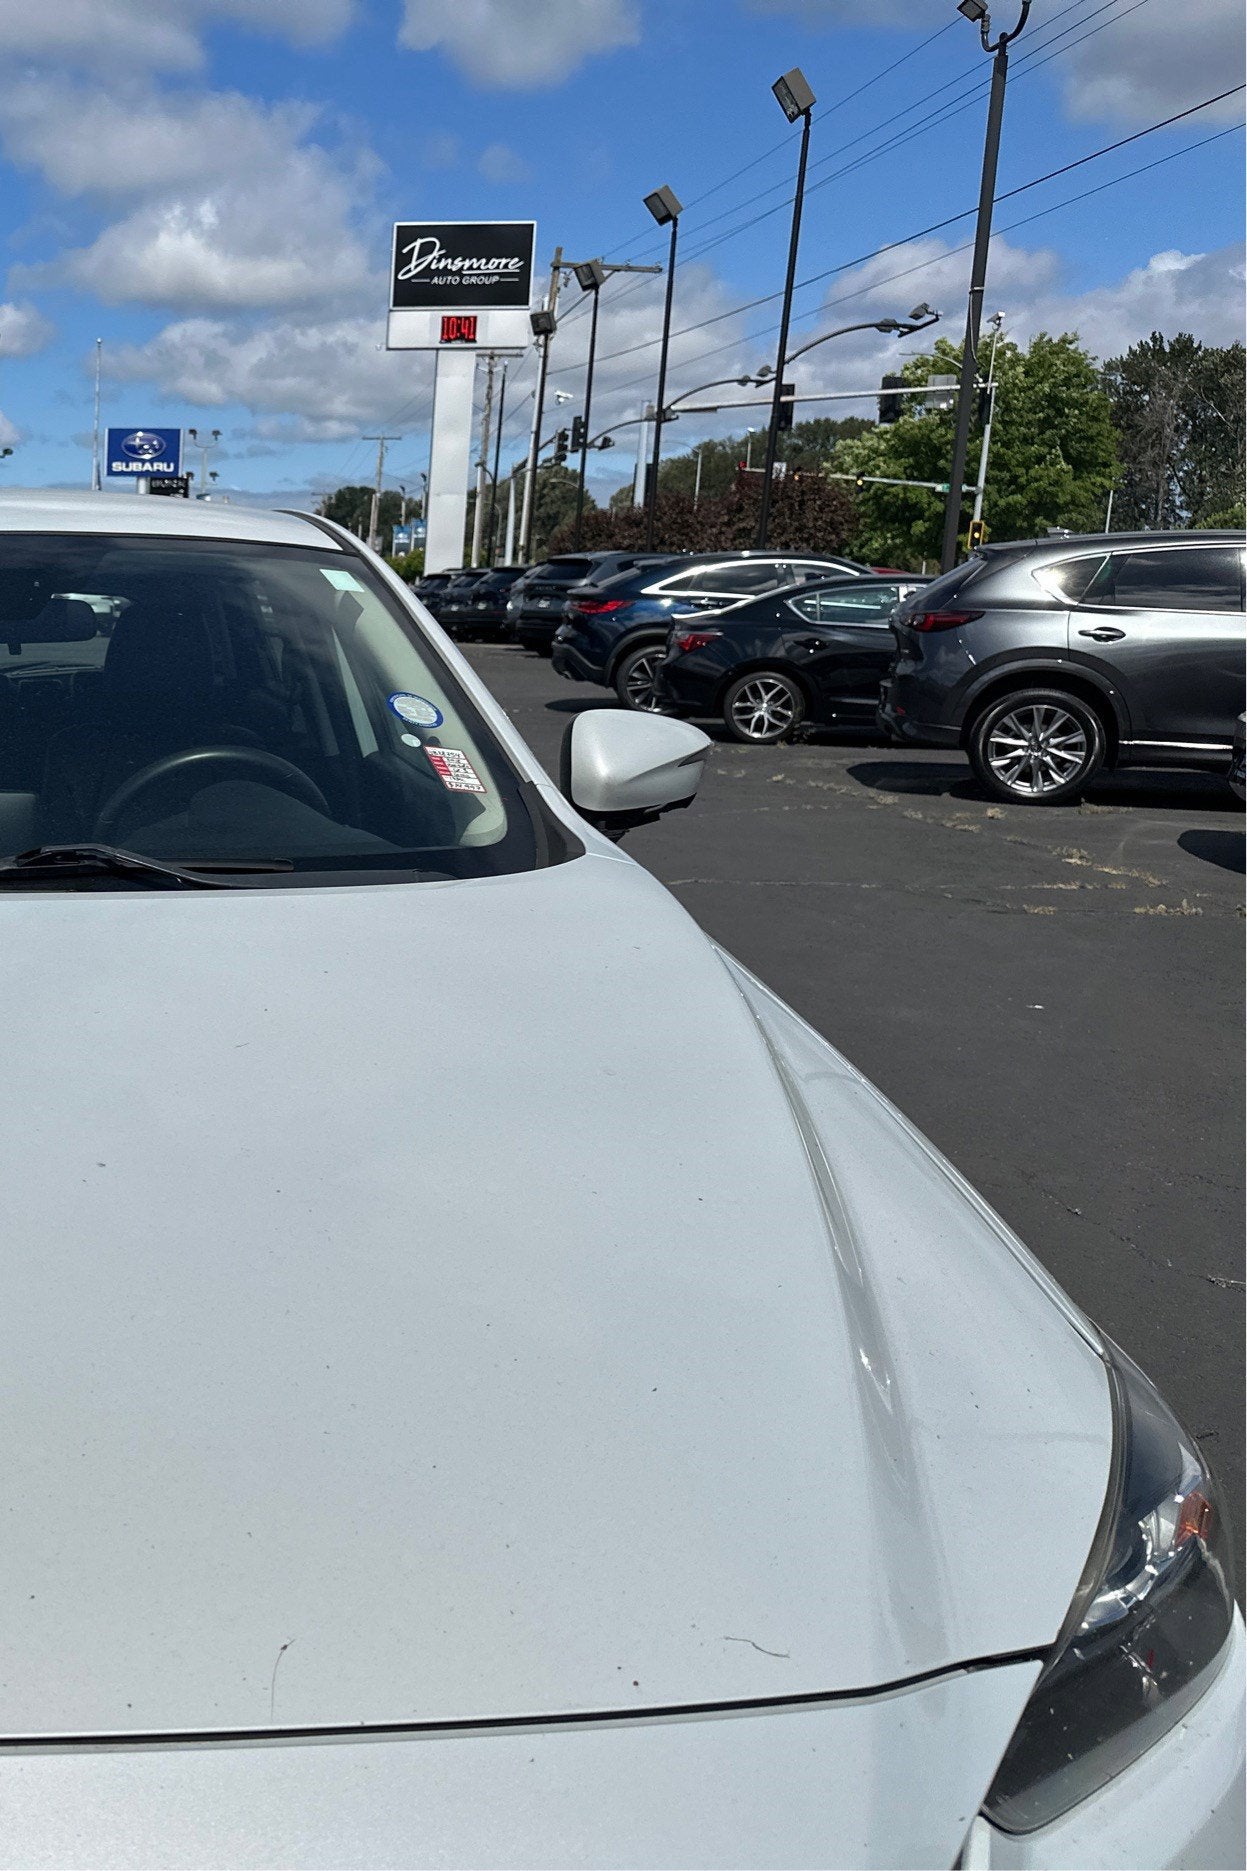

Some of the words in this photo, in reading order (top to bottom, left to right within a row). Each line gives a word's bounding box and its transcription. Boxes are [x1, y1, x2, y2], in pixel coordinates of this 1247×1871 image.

[397, 237, 524, 280] Dinsmore
[431, 276, 458, 285] AUTO
[462, 275, 500, 285] GROUP
[442, 317, 475, 340] 10:41
[112, 461, 174, 472] SUBARU
